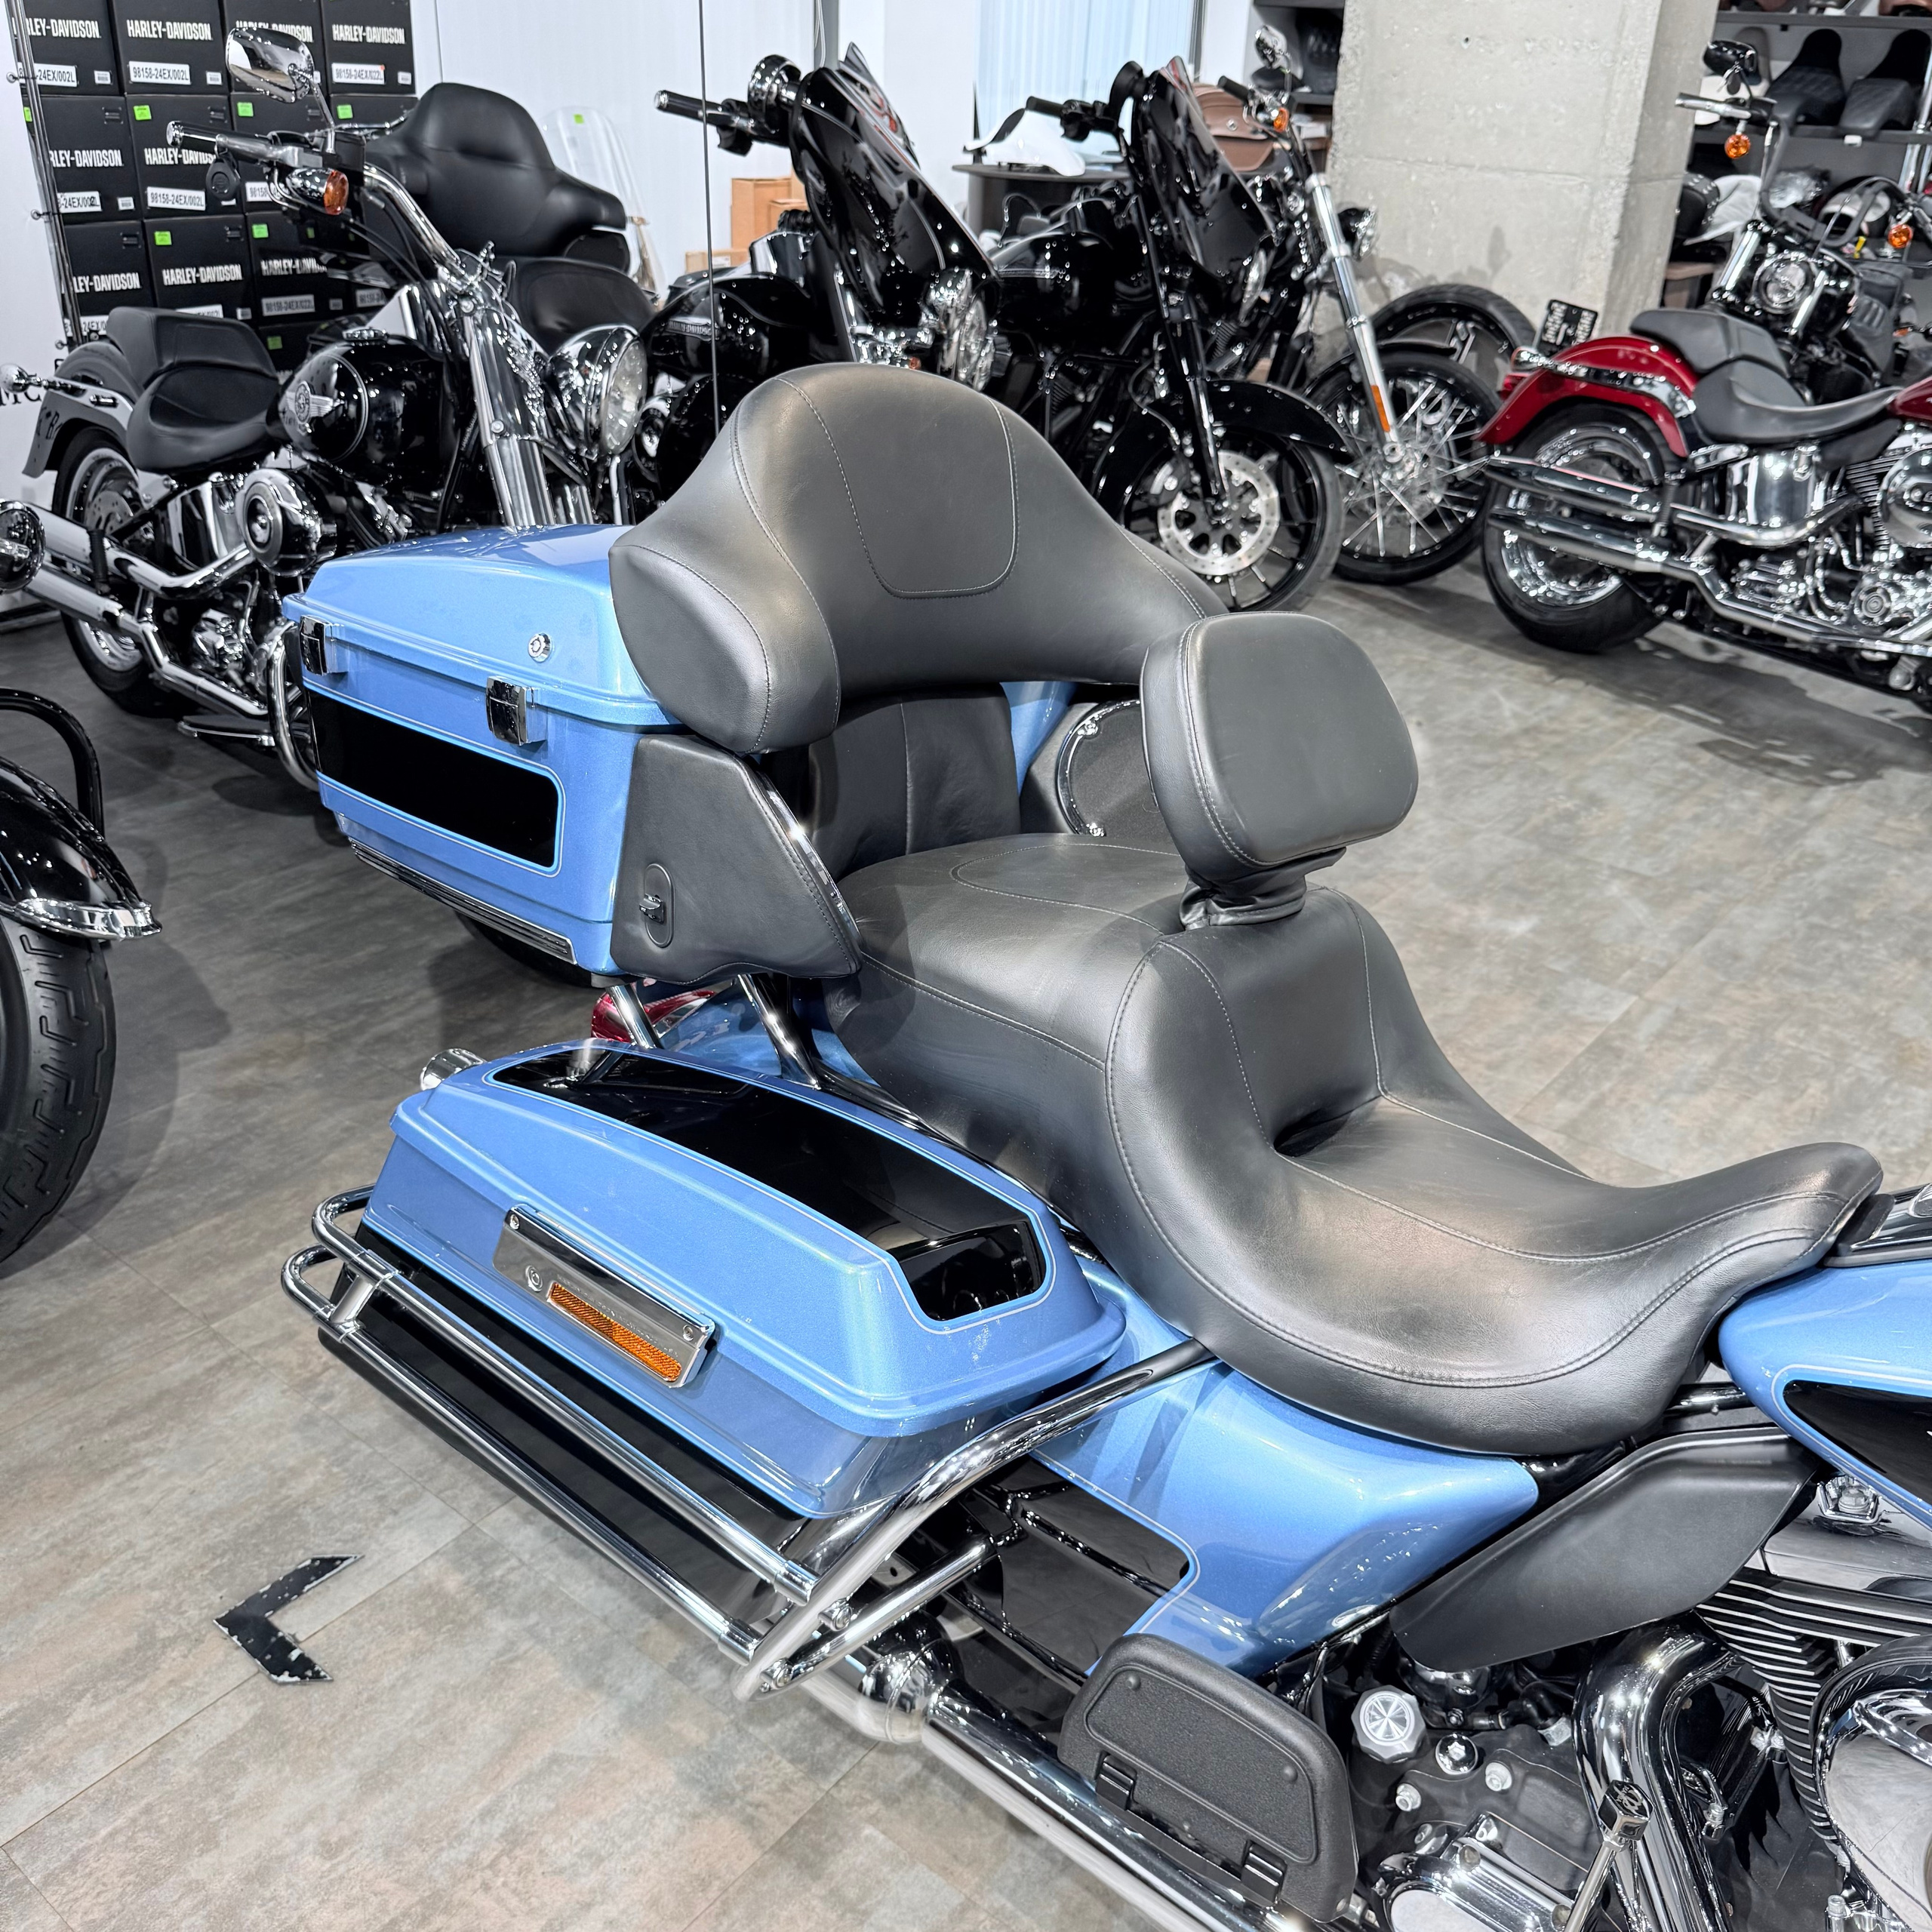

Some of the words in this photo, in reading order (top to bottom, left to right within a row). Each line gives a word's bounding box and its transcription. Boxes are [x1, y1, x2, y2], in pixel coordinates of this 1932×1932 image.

[126, 20, 213, 41] HARLEY-DAVIDSON
[332, 24, 406, 45] HARLEY-DAVIDSON
[133, 66, 189, 81] 98158-24EX/002L
[162, 264, 243, 286] HARLEY-DAVIDSON
